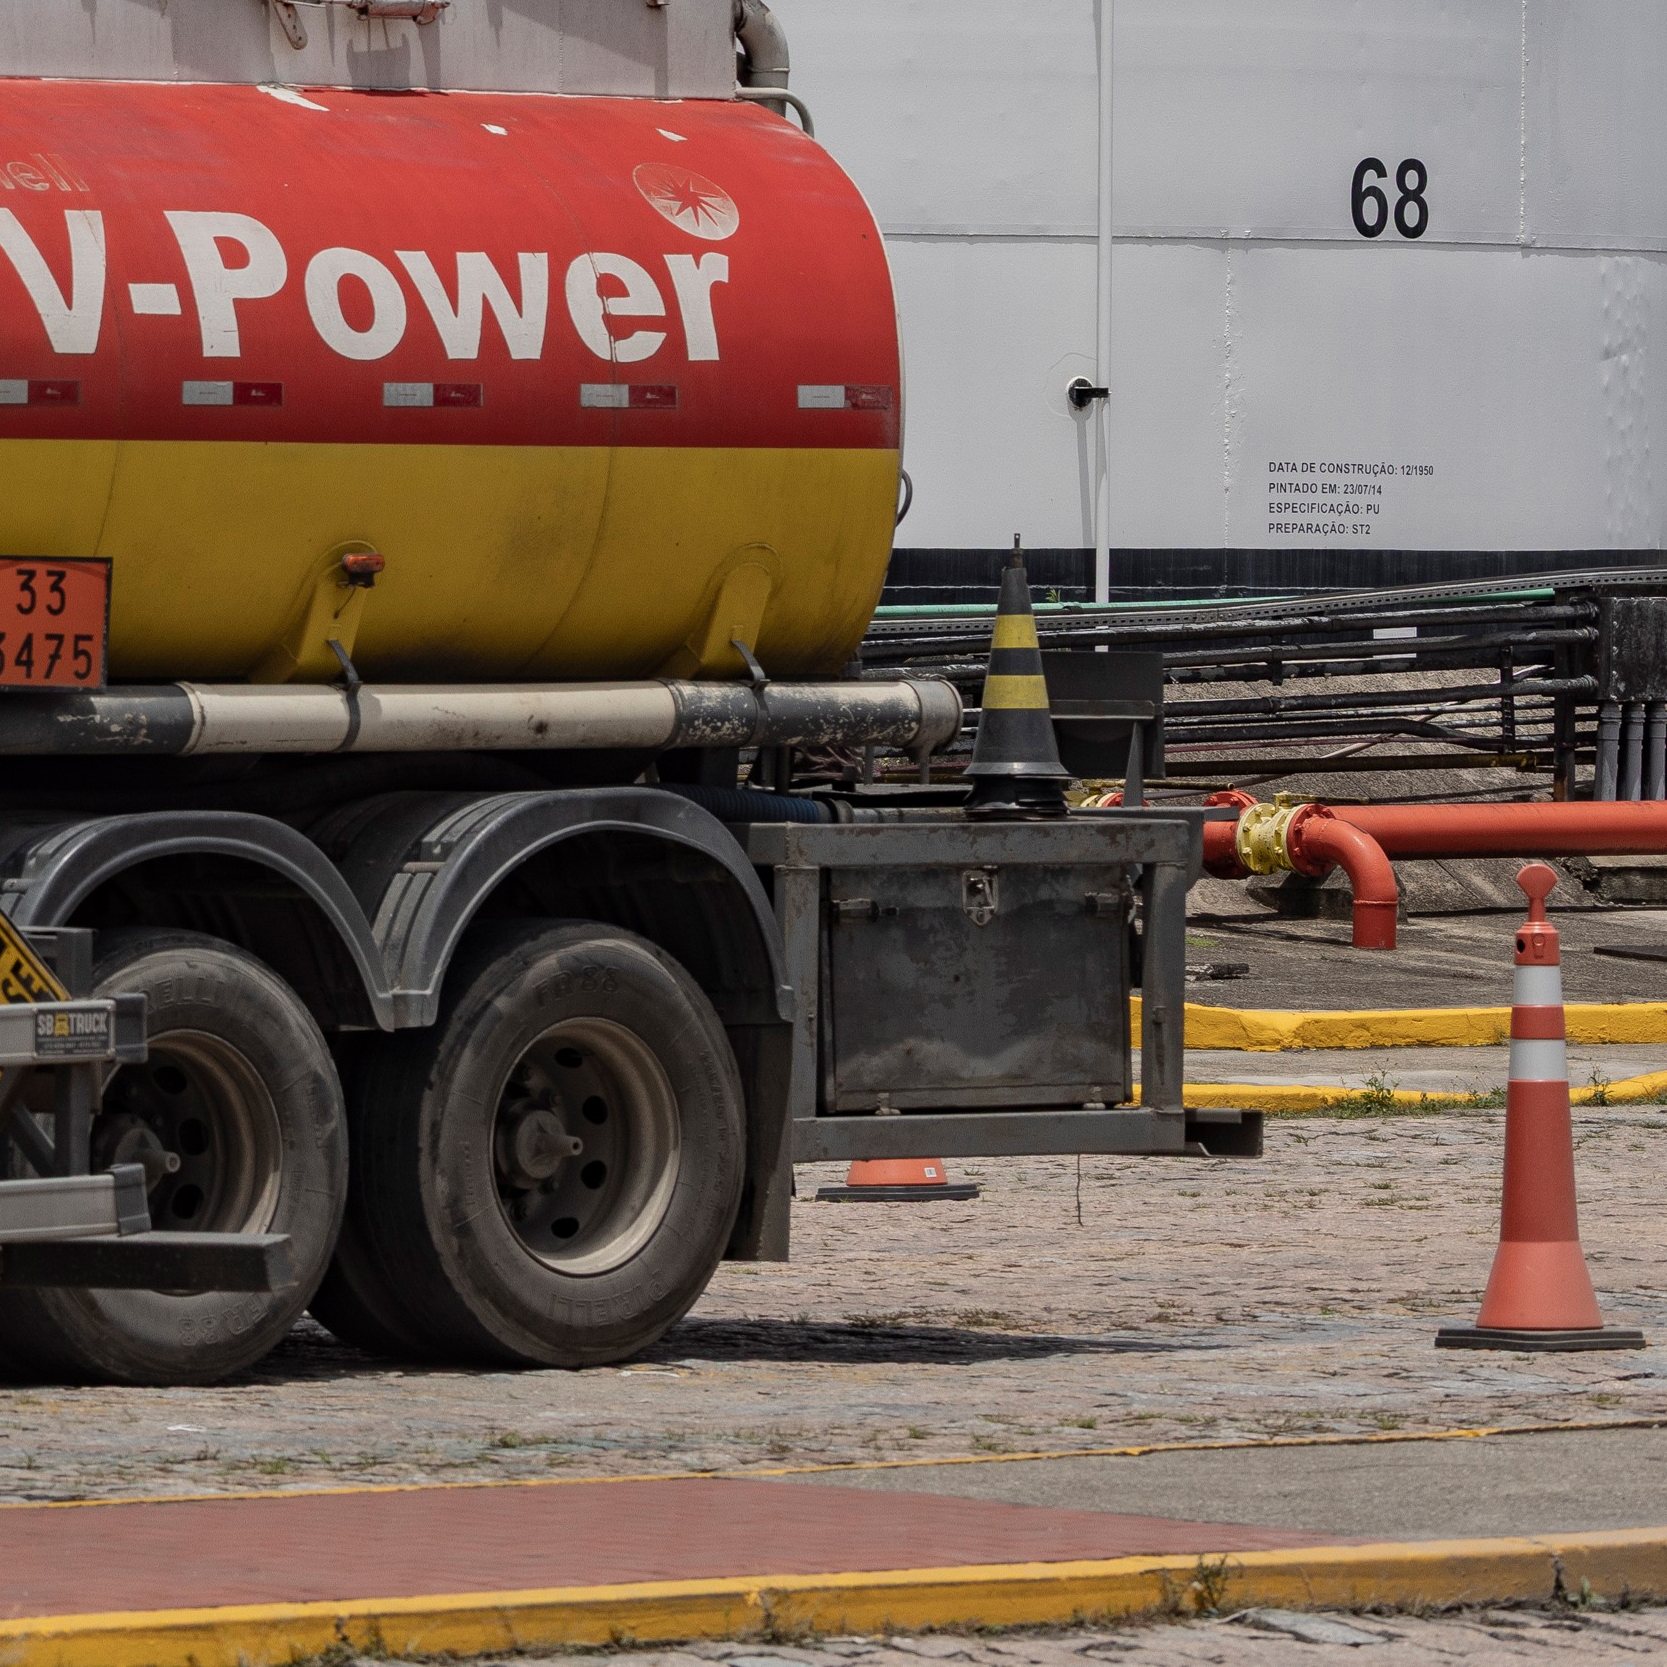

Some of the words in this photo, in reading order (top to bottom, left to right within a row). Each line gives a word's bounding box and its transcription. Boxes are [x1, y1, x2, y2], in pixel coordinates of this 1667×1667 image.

[1350, 157, 1429, 239] 68
[1268, 461, 1298, 473] DATA
[1301, 462, 1316, 473] DE
[1319, 461, 1398, 477] CONSTRUÇÃO:
[1401, 464, 1434, 476] 12/1950
[1268, 482, 1318, 494] PINTADO
[1321, 483, 1341, 494] EM:
[1343, 484, 1383, 495] 23/07/14
[1268, 501, 1363, 516] ESPECIFICAÇÃO:
[1366, 503, 1380, 514] PU
[1268, 521, 1349, 536] PREPARAÇÃO:
[1351, 523, 1371, 534] ST2
[15, 568, 68, 617] 33
[69, 1012, 108, 1035] TRUCK
